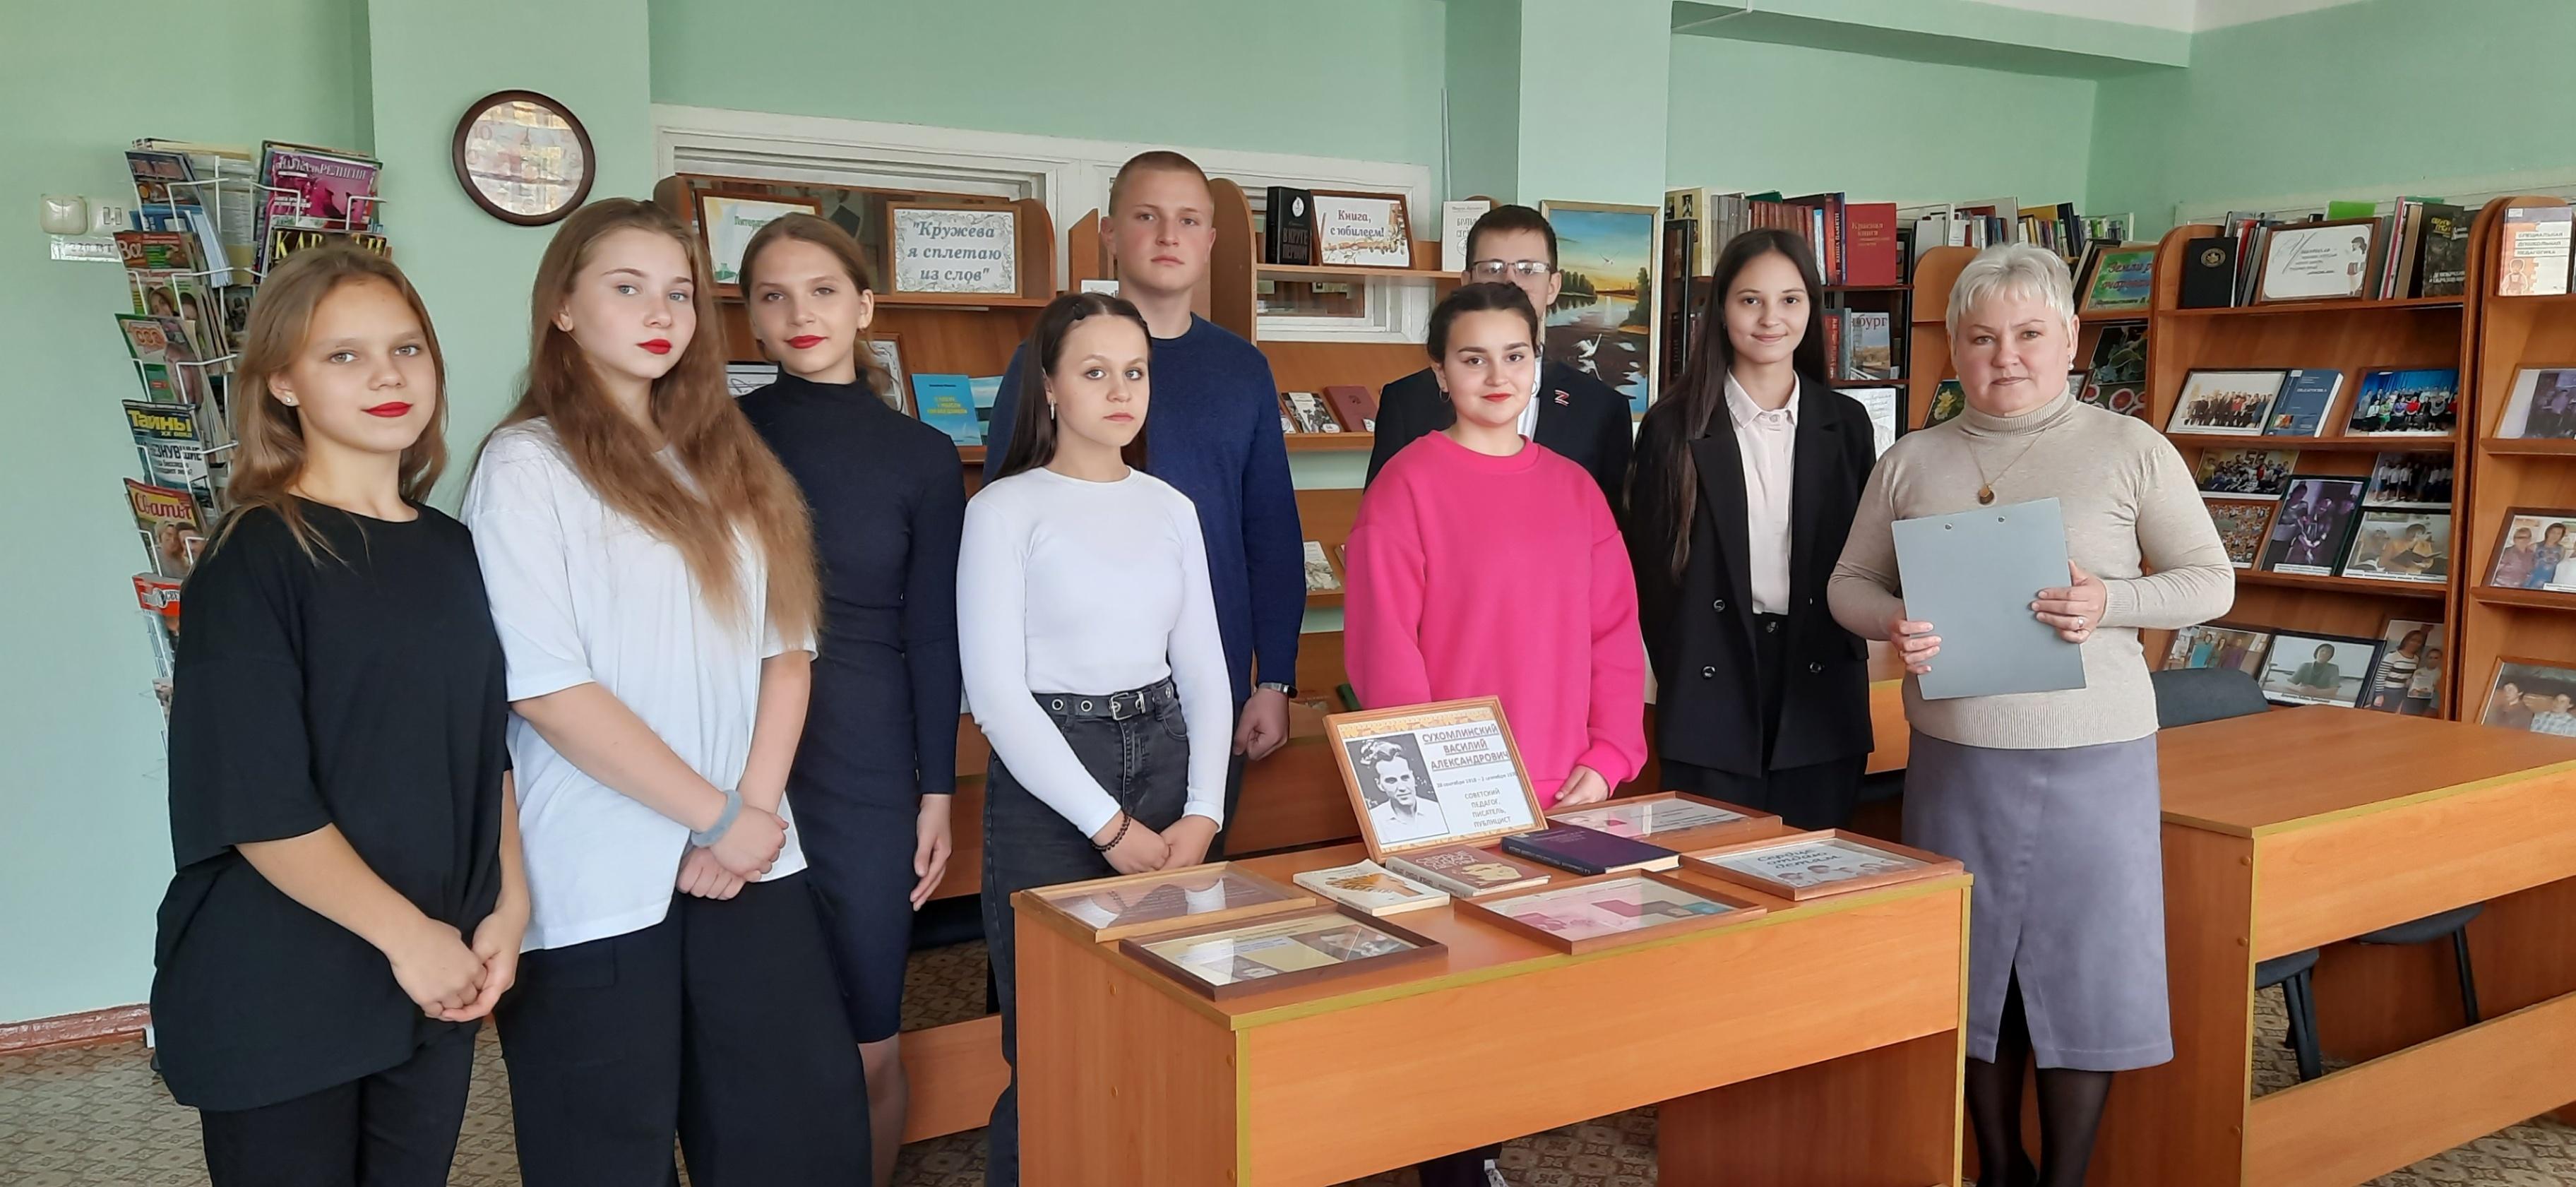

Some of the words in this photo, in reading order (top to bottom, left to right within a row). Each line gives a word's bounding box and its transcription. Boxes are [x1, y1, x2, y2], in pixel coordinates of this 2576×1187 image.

[1338, 210, 1371, 223] Книга,
[913, 221, 995, 239] "Кружева
[1337, 225, 1384, 237] юбилеем!
[907, 247, 918, 258] я
[923, 248, 1001, 260] сплетаю
[920, 270, 939, 280] из
[944, 268, 990, 283] слов"
[1422, 723, 1499, 743] СУХОМЛИНСКИЙ
[1443, 739, 1488, 753] ВАСИЛИЙ
[1431, 751, 1510, 770] АЛЕКСАНДРОВИЧ
[1465, 787, 1501, 799] СОВЕТСКИЙ
[1472, 808, 1506, 818] ПИСАТЕЛЬ,
[1474, 816, 1510, 828] ПУБЛИЦИСТ
